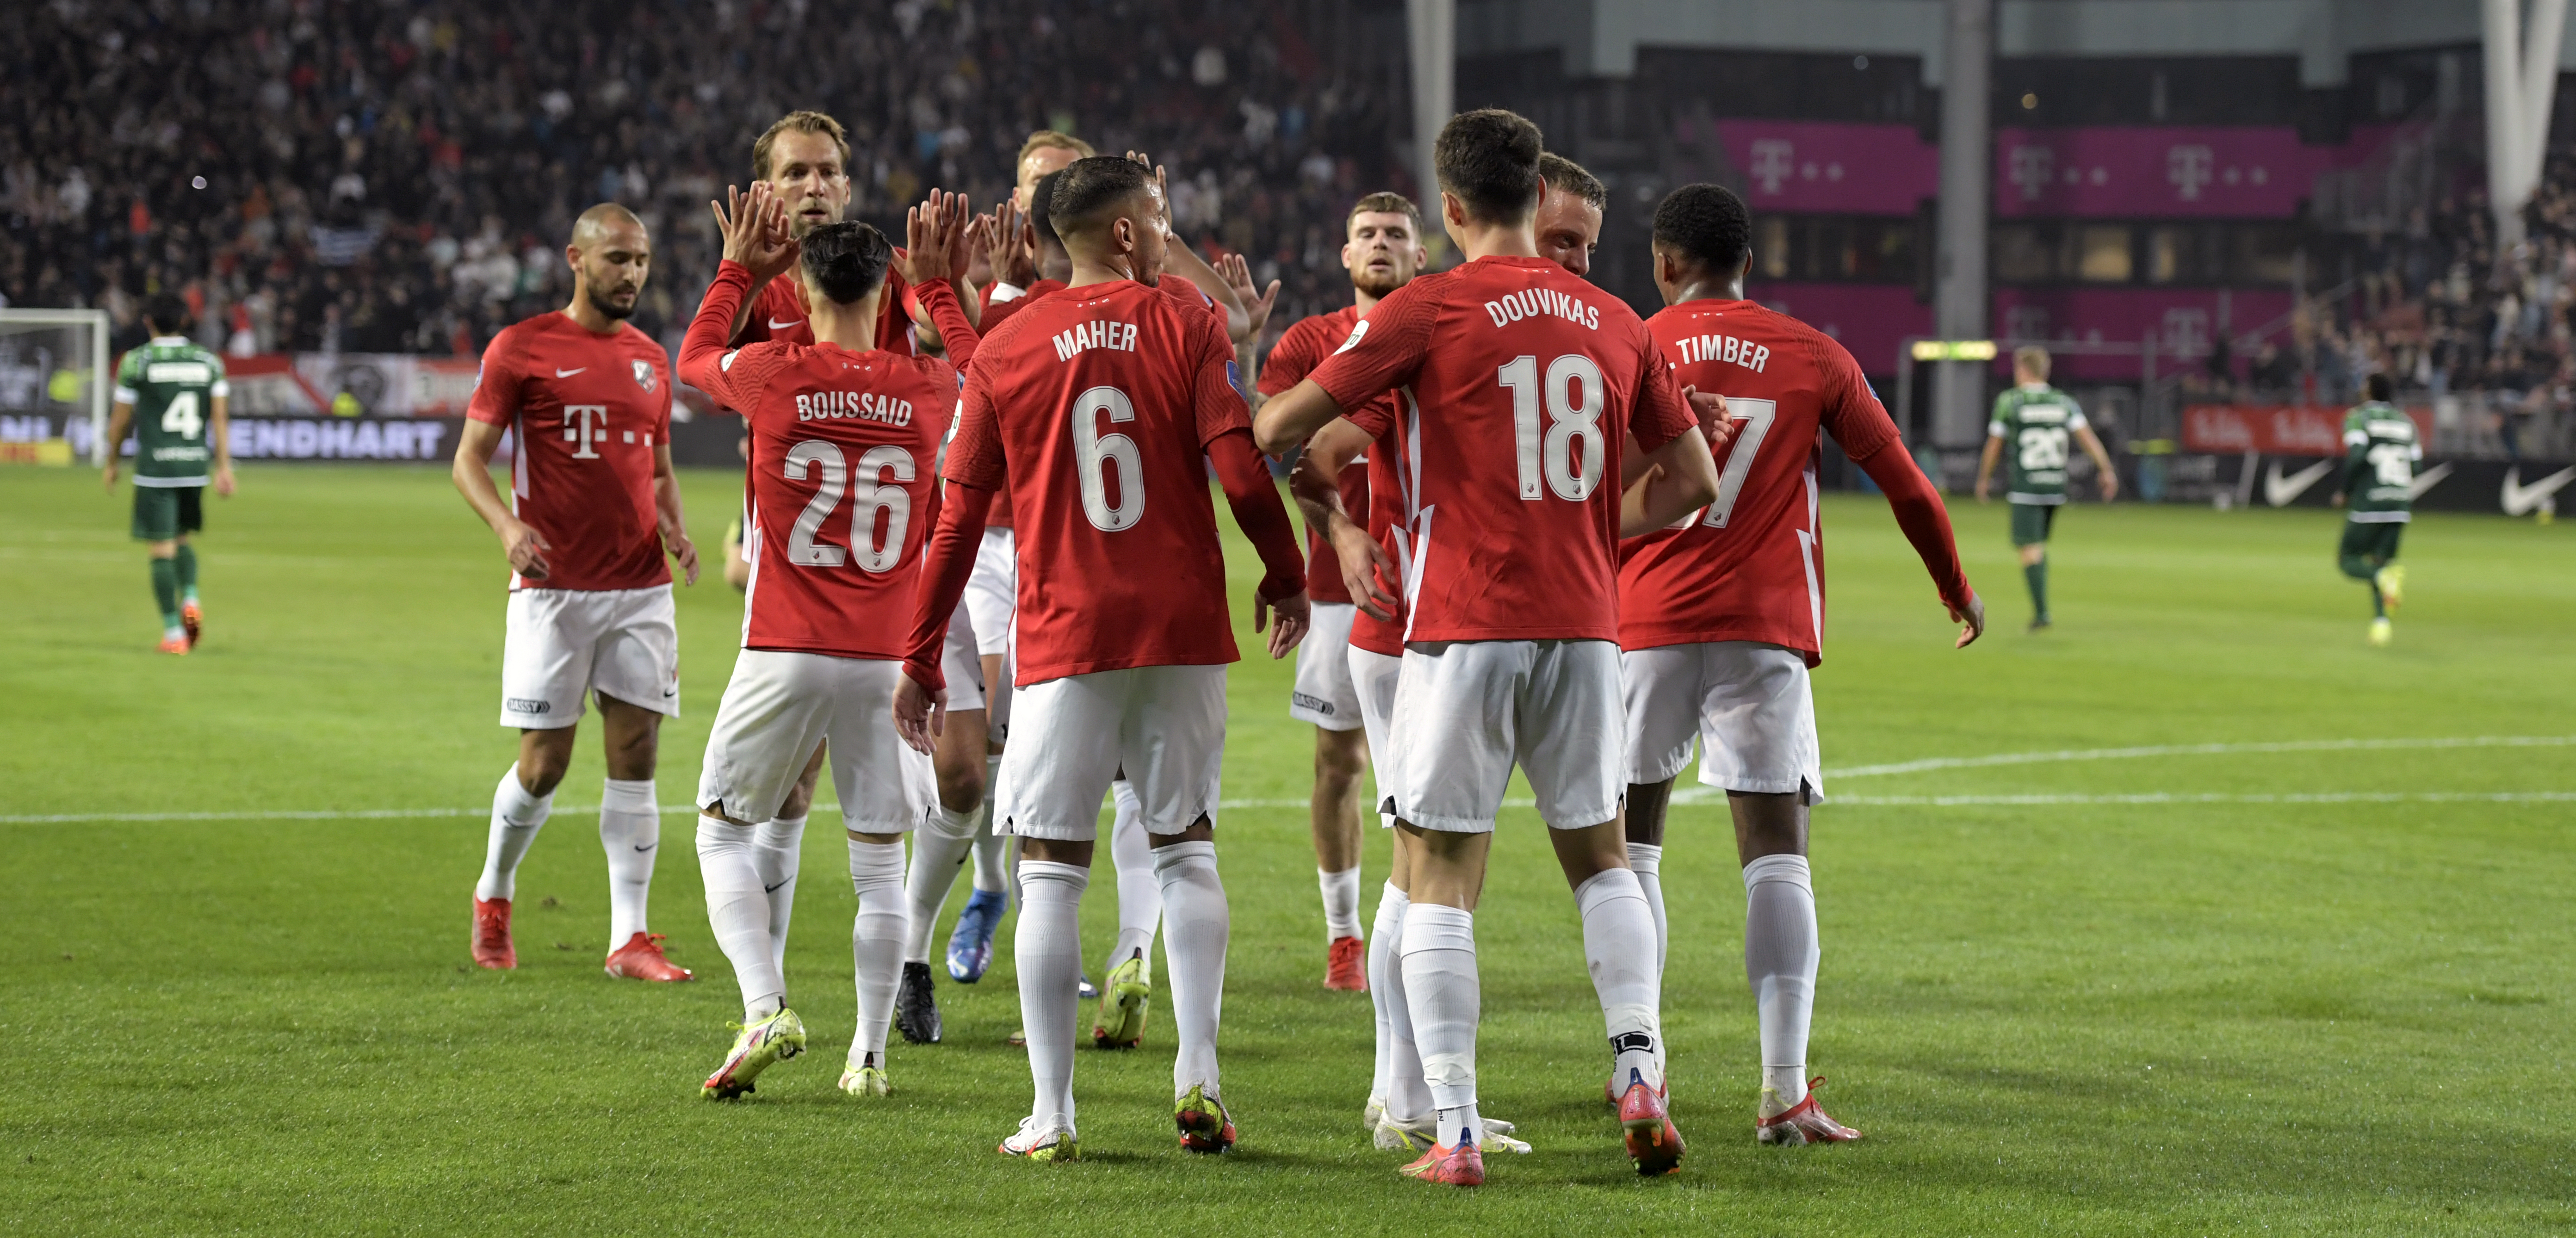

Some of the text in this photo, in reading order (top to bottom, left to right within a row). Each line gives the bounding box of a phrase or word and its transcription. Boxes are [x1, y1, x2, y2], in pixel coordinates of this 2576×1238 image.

[1485, 288, 1599, 330] DOUVIKAS
[1052, 320, 1137, 362] MAHER
[1676, 335, 1770, 373] TIMBER
[161, 391, 204, 440] 4
[564, 405, 607, 458] T
[796, 391, 912, 427] BOUSSAID
[1499, 354, 1604, 501] 18
[206, 418, 447, 459] ENDHART
[1072, 386, 1145, 532] 6
[1663, 397, 1776, 529] 7
[784, 439, 915, 573] 26
